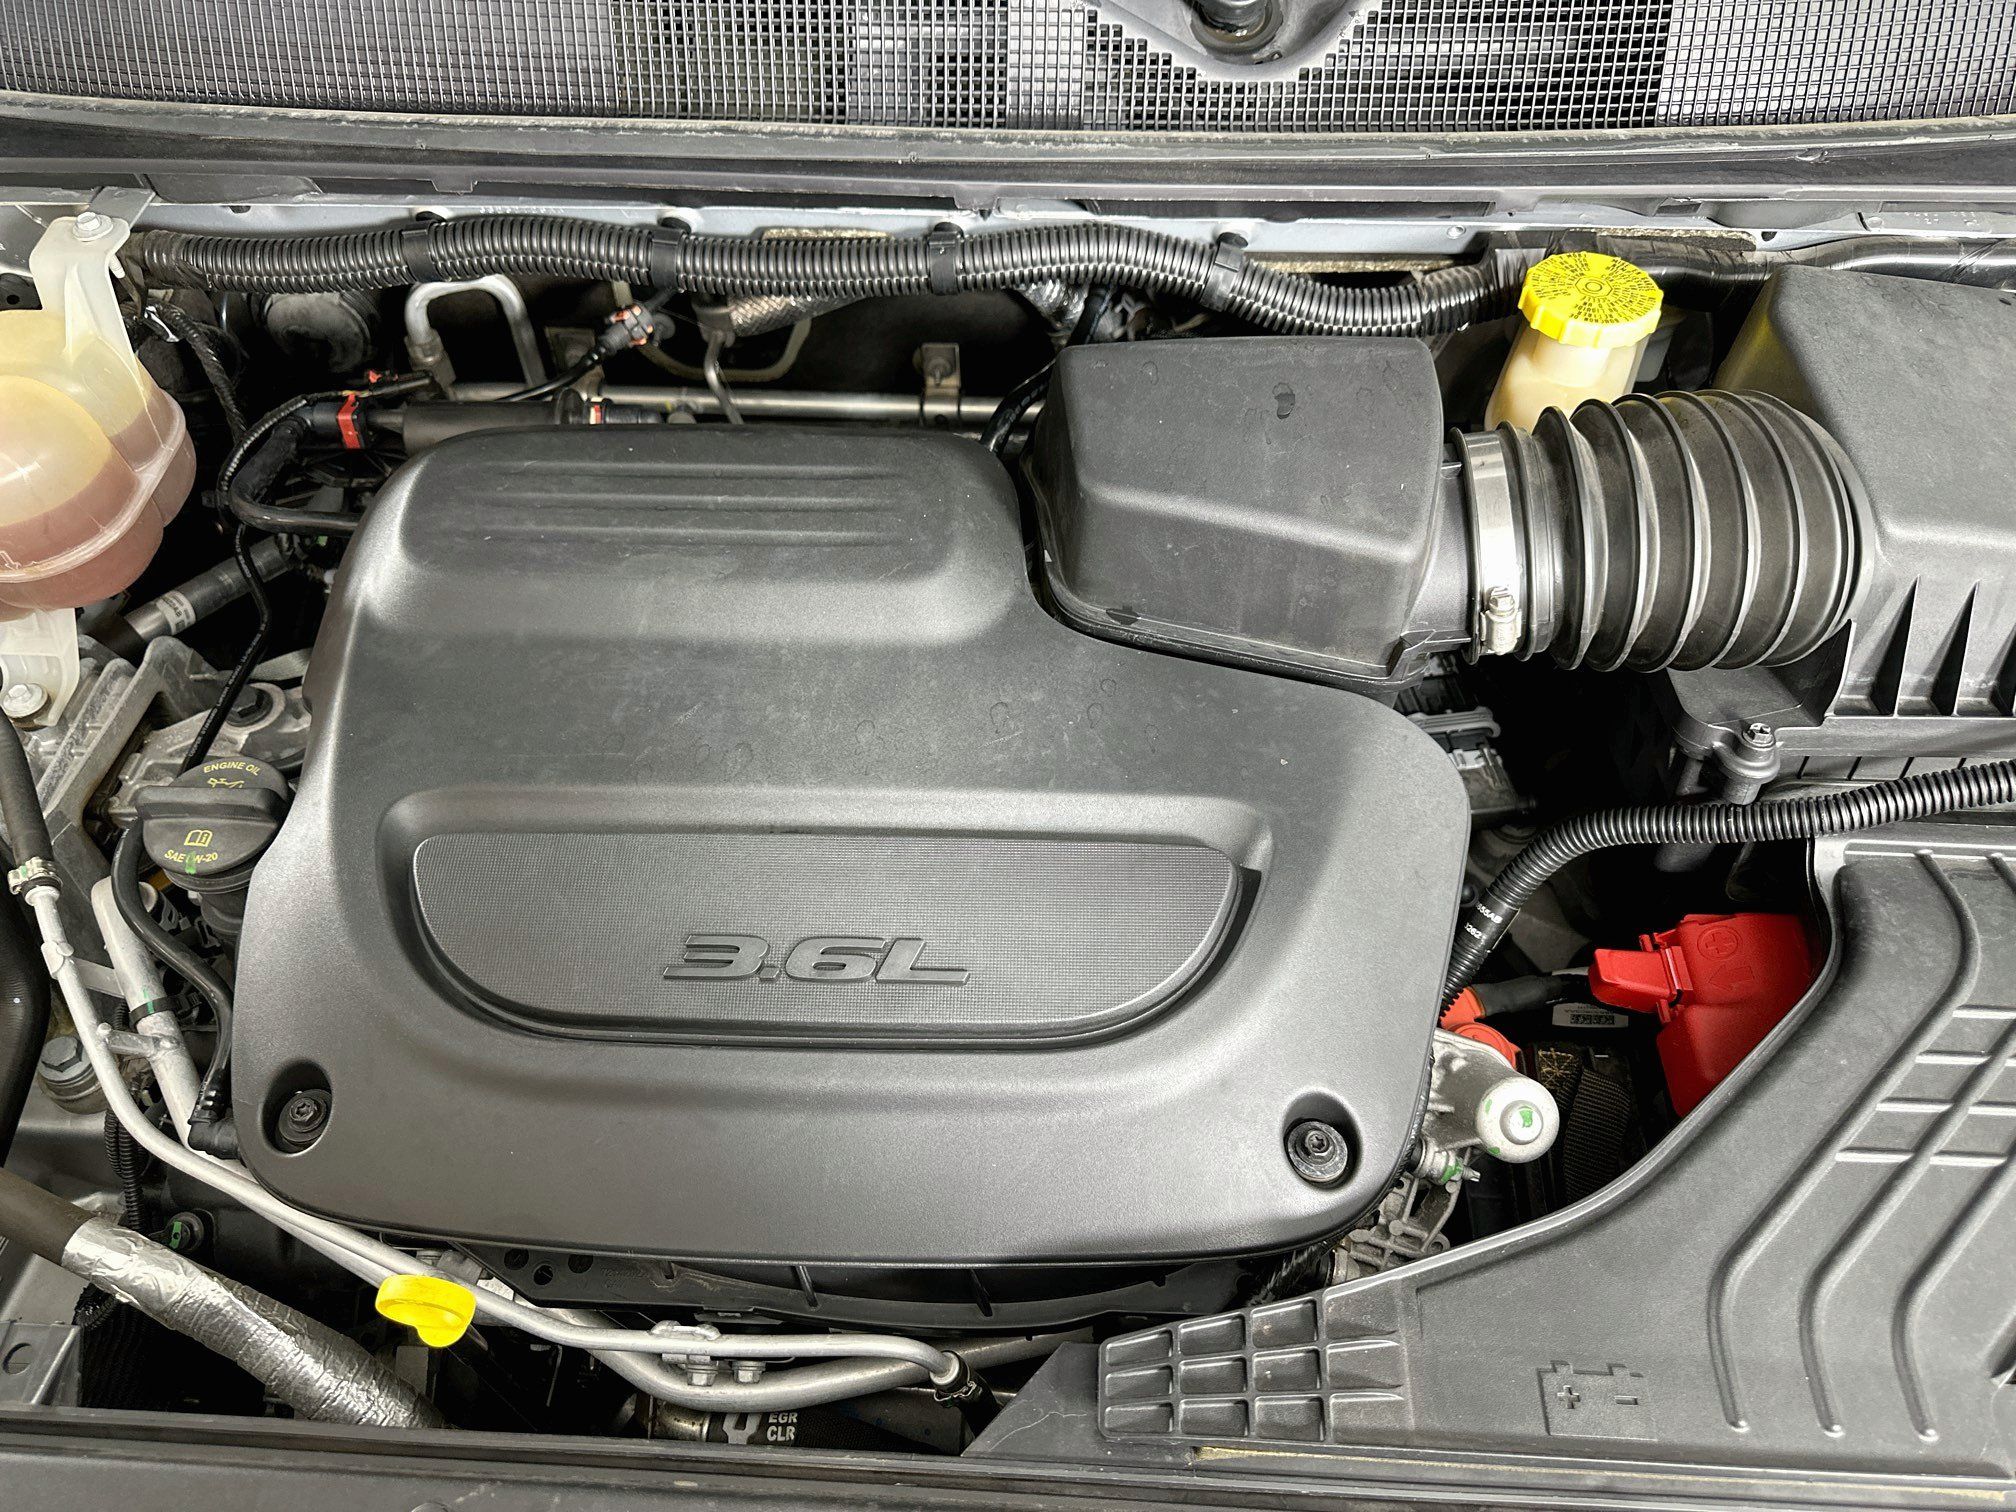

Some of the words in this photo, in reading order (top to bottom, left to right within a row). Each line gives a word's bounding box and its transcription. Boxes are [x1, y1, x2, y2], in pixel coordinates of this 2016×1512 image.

[203, 761, 245, 774] ENGINE
[245, 763, 261, 776] OIL
[164, 849, 185, 863] SAE
[662, 933, 971, 984] 3.6L
[768, 1411, 798, 1424] EGR
[766, 1424, 796, 1442] CLR
